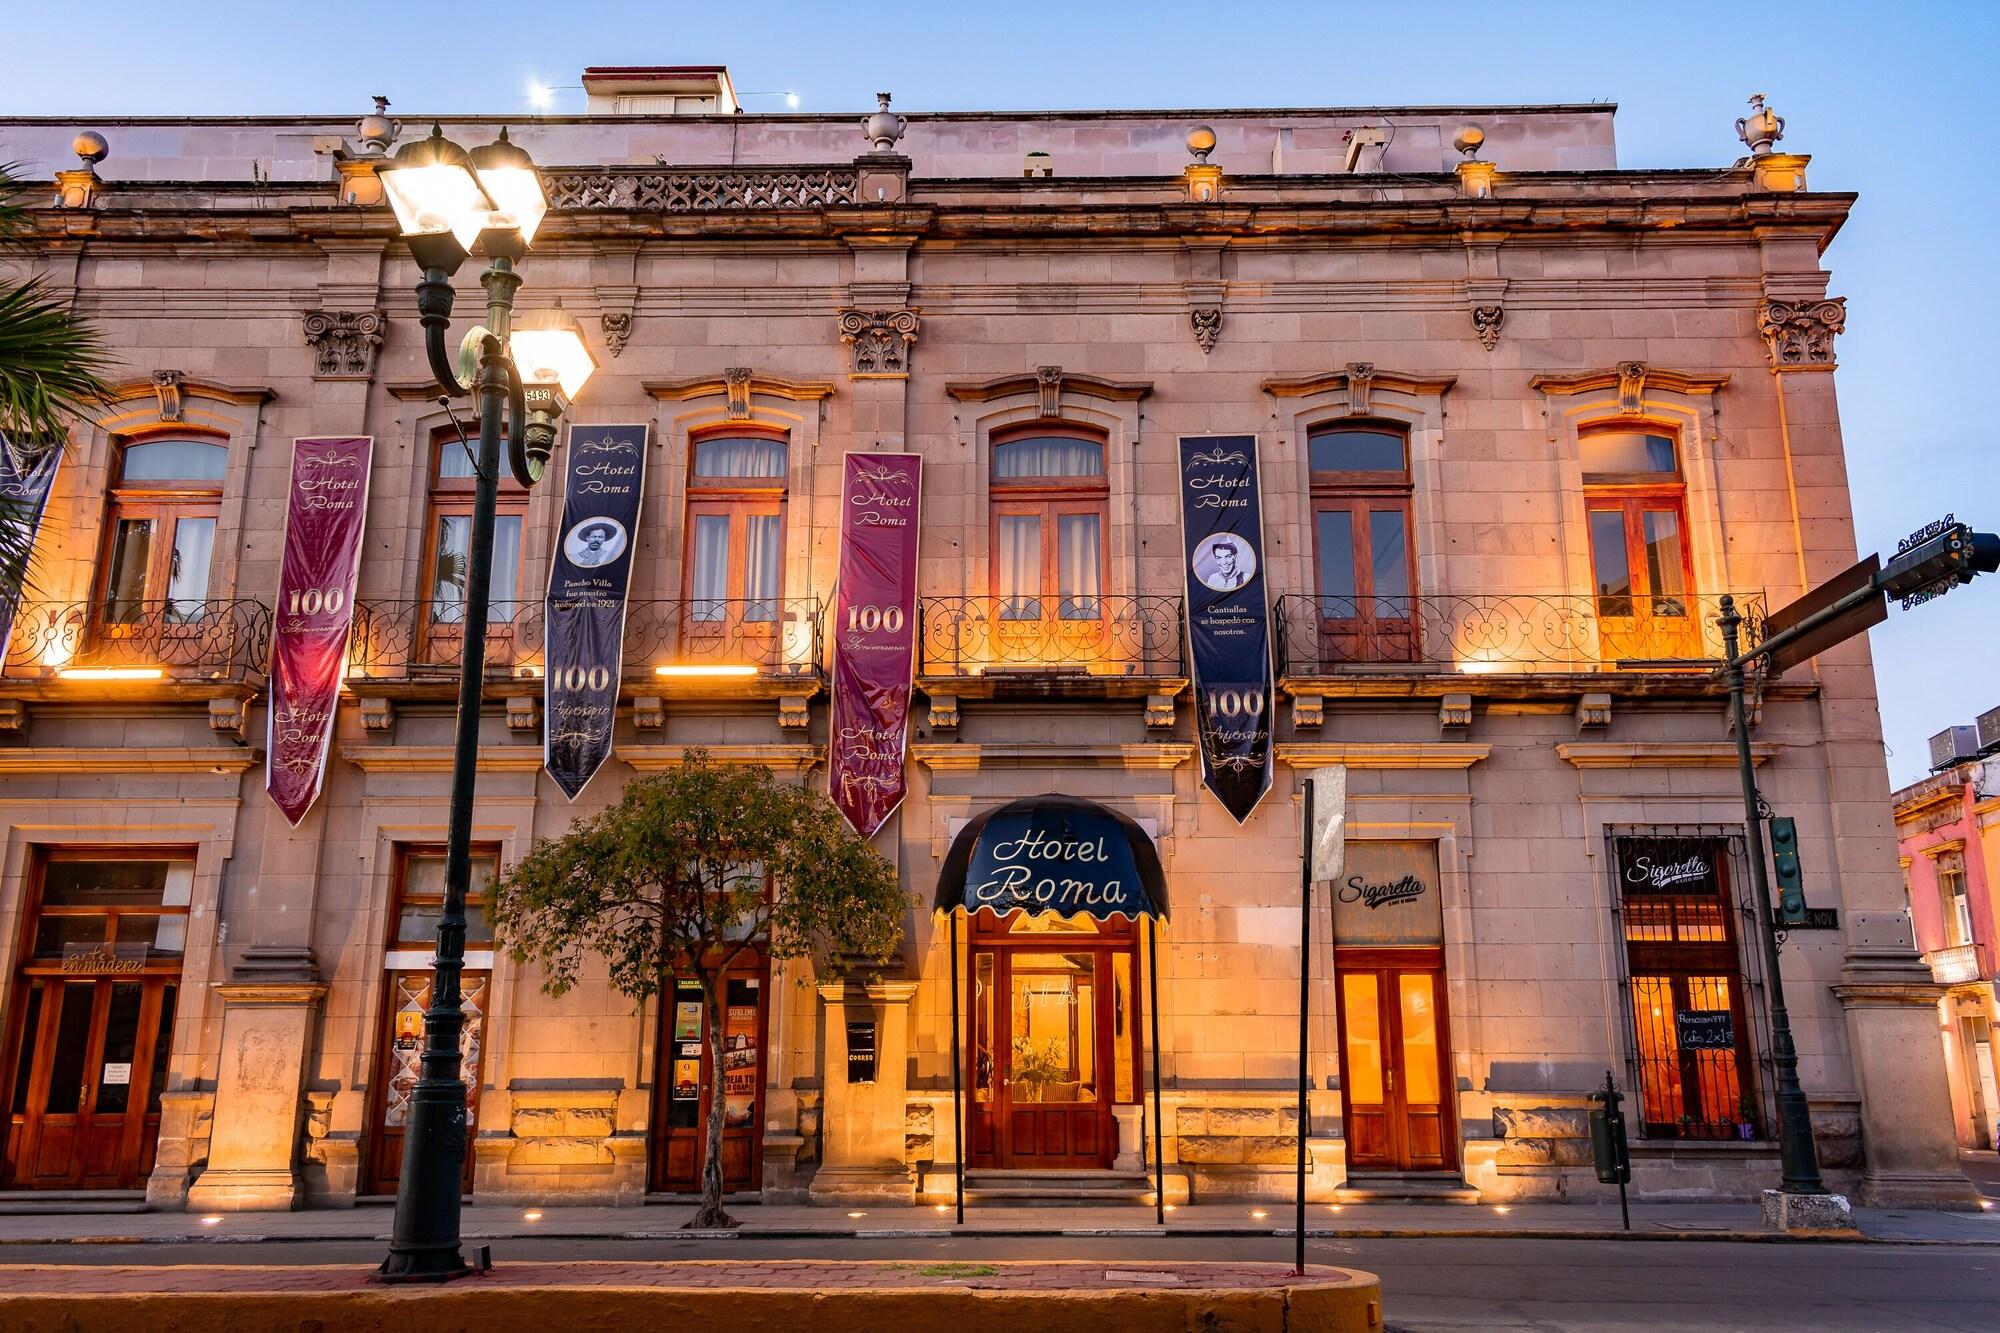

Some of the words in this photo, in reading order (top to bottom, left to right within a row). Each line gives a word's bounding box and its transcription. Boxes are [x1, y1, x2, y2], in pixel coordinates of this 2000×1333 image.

[526, 390, 549, 401] 5493
[575, 462, 635, 476] Hotel
[298, 476, 359, 490] Hotel
[577, 480, 631, 494] Roma
[1189, 474, 1250, 489] Hotel
[301, 495, 354, 510] Roma
[851, 491, 911, 508] Hotel
[1194, 493, 1249, 509] Roma
[852, 511, 908, 527] Roma
[564, 579, 591, 588] Pancho
[592, 578, 612, 587] Villa
[288, 588, 344, 616] 100
[1207, 604, 1247, 614] Cantinflas
[281, 617, 343, 634] Aniversario
[847, 604, 904, 633] 100
[1209, 616, 1241, 626] hospedó
[842, 635, 906, 652] Aniversario
[552, 665, 610, 693] 100
[1208, 689, 1265, 718] 100
[274, 707, 330, 724] Hote
[840, 724, 900, 741] Hotel
[1203, 725, 1269, 744] Aniversario
[843, 745, 896, 761] Roma
[993, 829, 1109, 862] Hotel
[1627, 855, 1710, 889] Sigaretta
[977, 865, 1128, 905] Roma
[1338, 875, 1426, 910] Sigaretta
[1814, 912, 1833, 926] NOV
[85, 955, 142, 973] madera
[849, 1054, 874, 1062] CORREO
